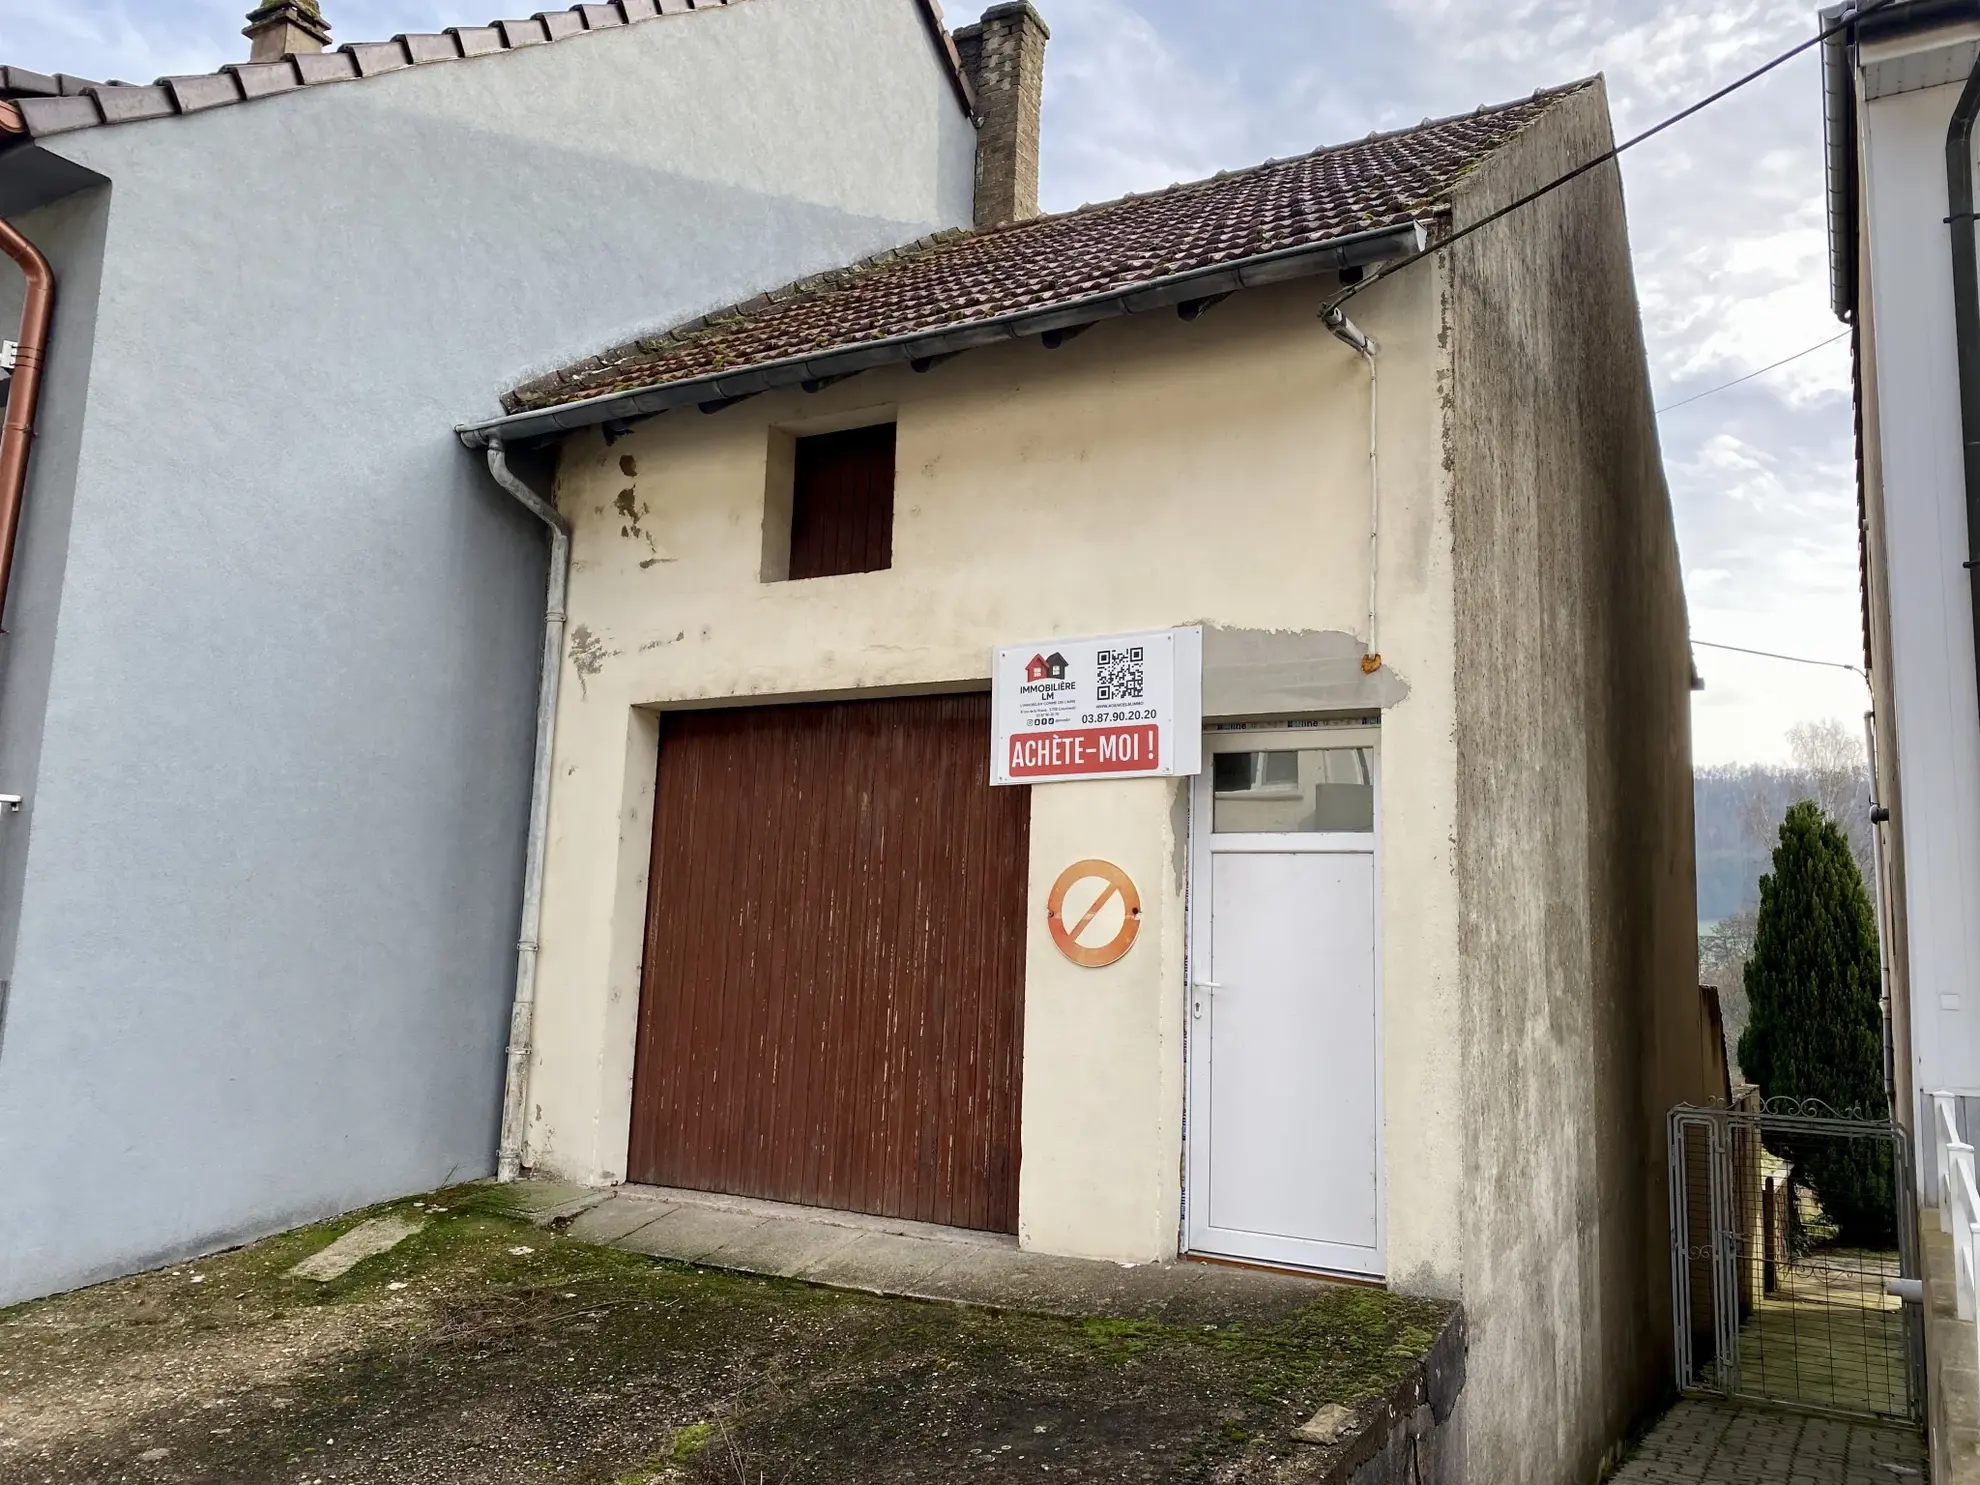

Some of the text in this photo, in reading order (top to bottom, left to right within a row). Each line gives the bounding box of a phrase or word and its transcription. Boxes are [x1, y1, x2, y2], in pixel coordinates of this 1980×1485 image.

[1020, 681, 1076, 694] IMMOBILIÈRE
[1041, 692, 1054, 701] LM
[1081, 709, 1157, 724] 03.87.90.20.20
[1011, 730, 1155, 768] ACHÈTE-MOI !
